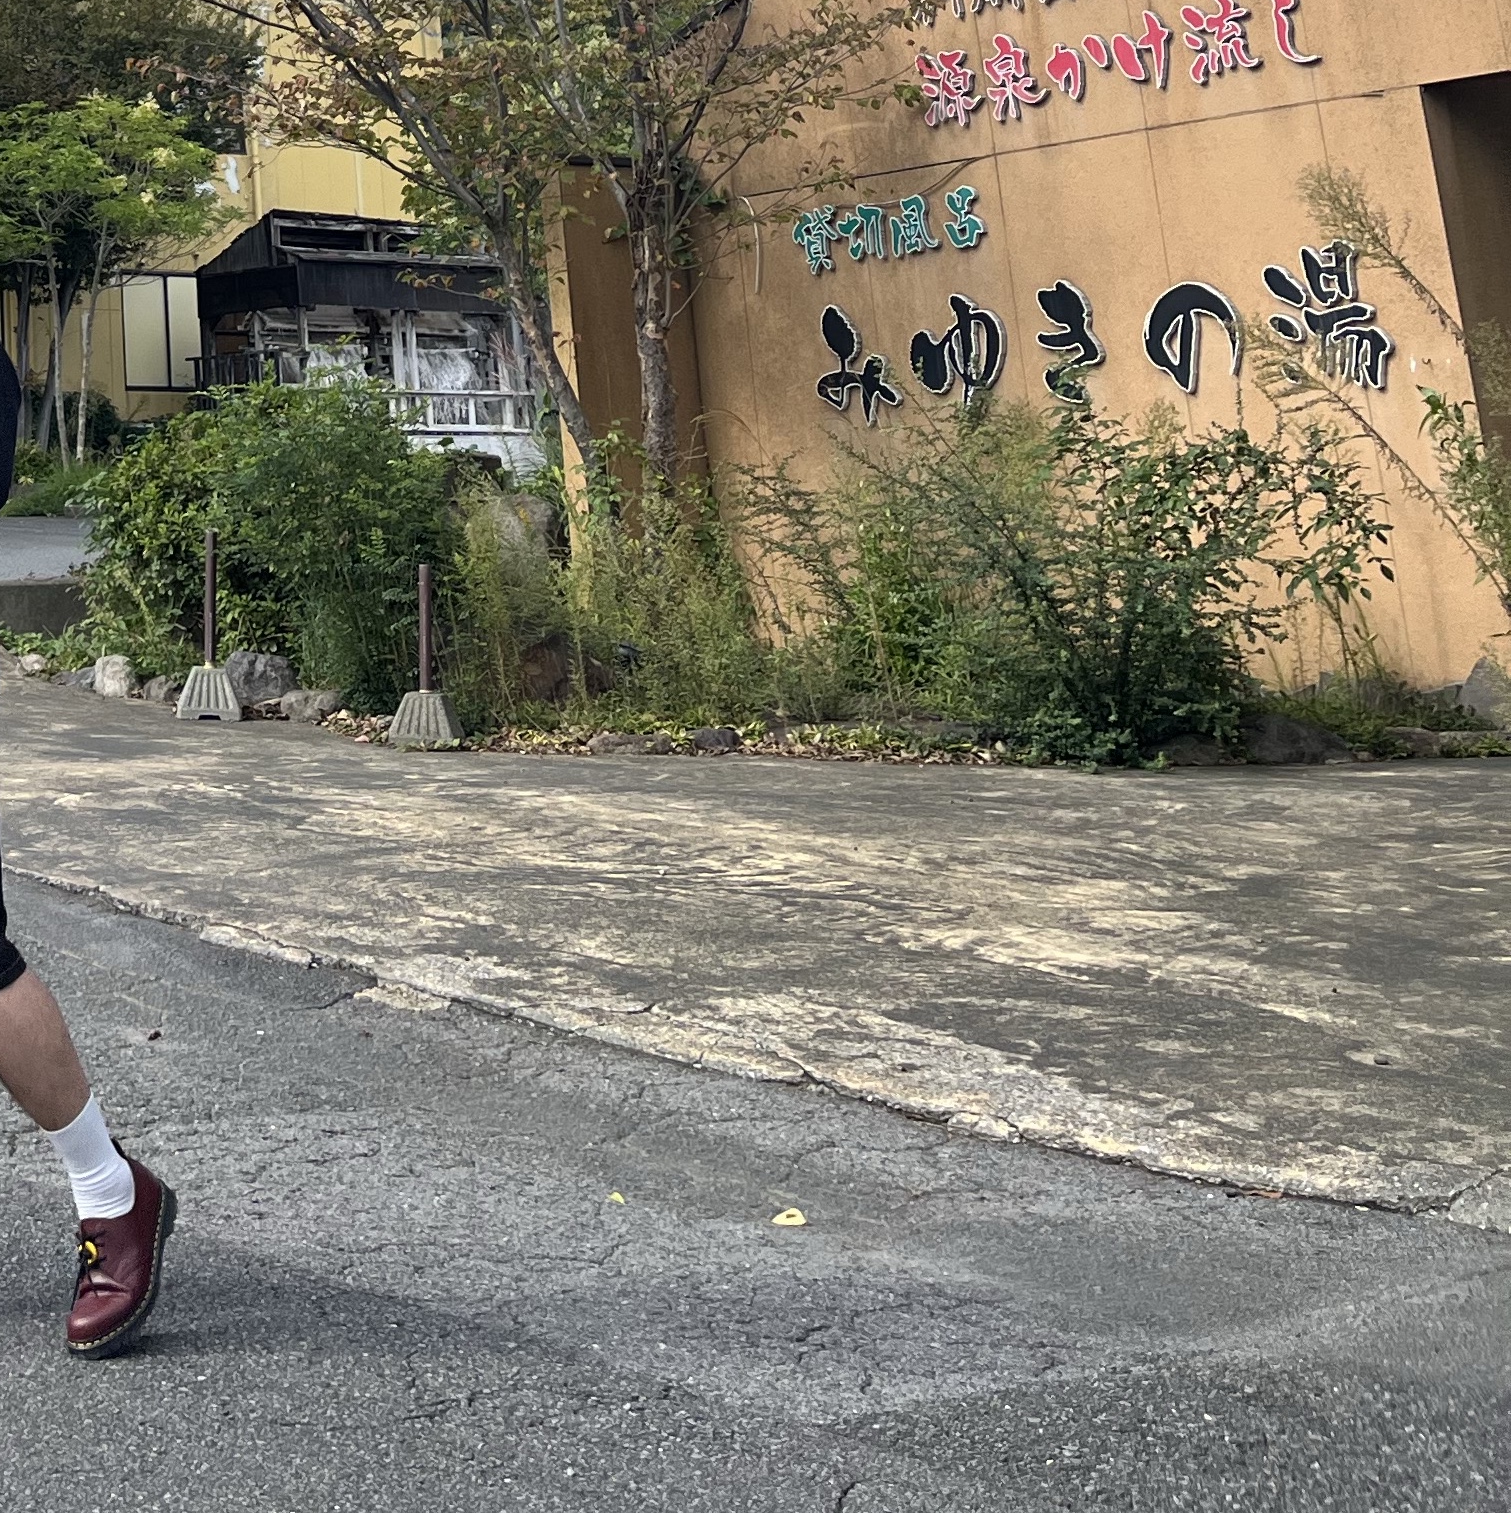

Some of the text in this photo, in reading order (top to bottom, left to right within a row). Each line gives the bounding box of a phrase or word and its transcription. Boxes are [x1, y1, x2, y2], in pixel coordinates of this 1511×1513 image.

[792, 185, 986, 275] 貸切風呂
[817, 241, 1393, 426] みゆきの湯
